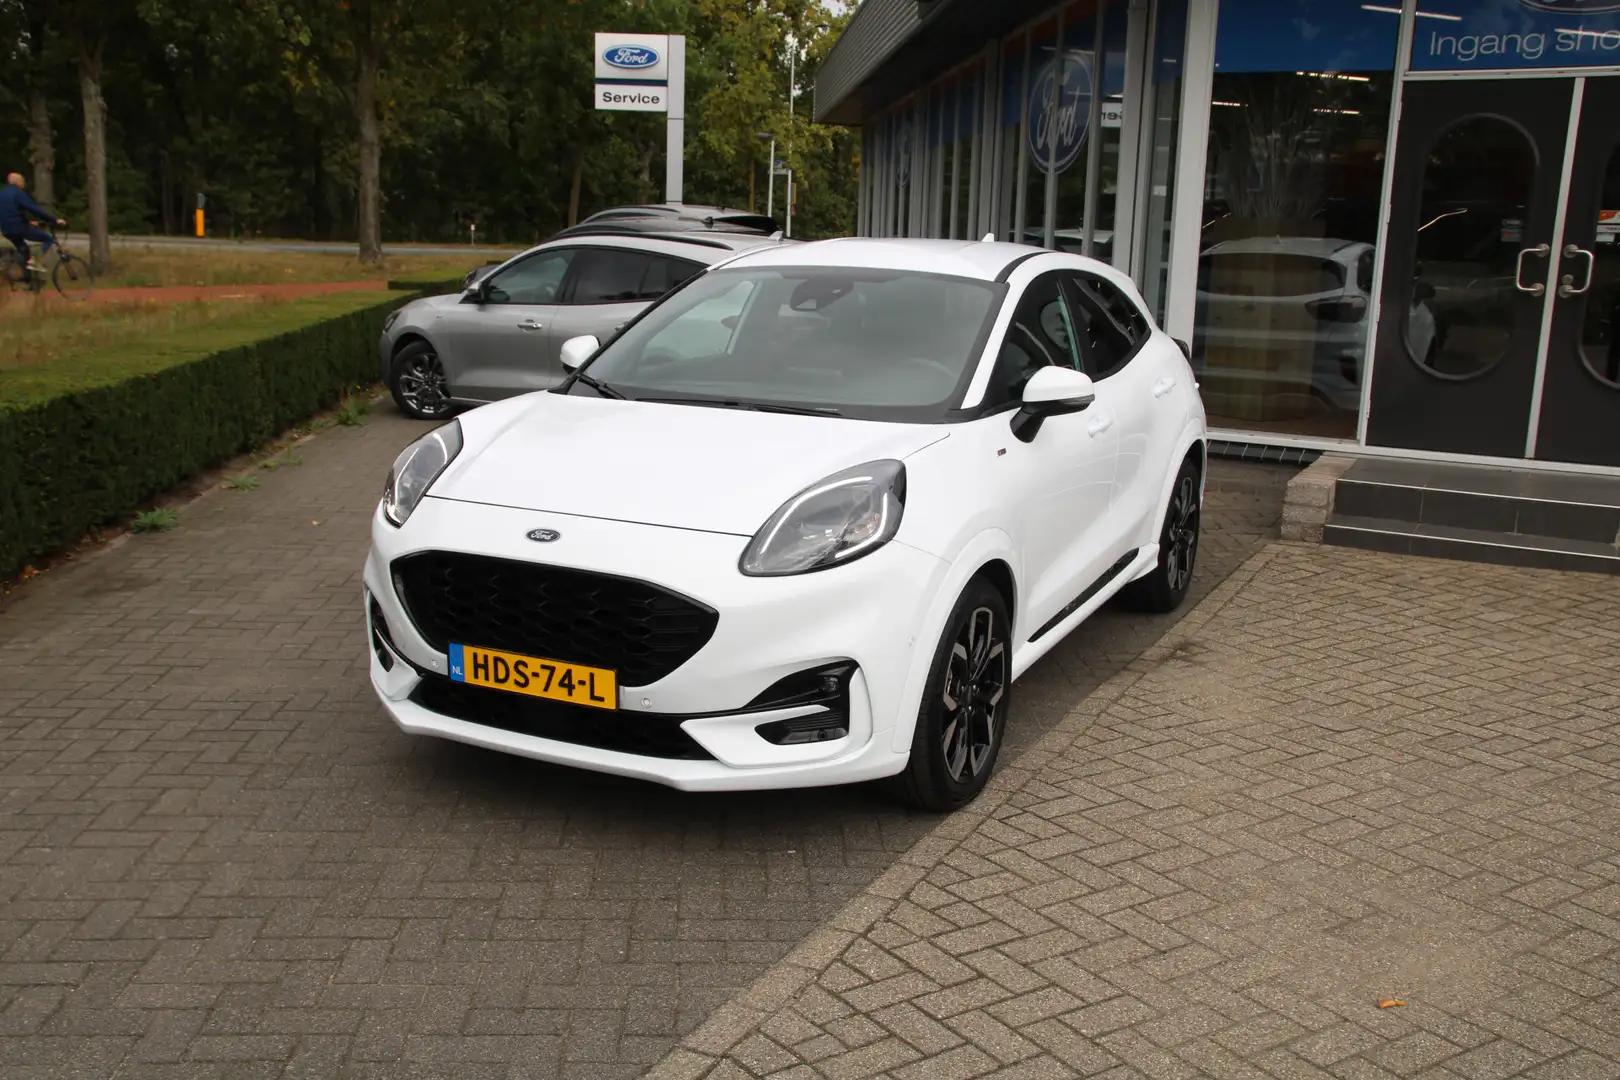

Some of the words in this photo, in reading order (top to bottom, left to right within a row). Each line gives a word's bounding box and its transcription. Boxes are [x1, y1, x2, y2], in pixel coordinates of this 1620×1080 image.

[614, 47, 649, 64] Ford
[1430, 31, 1546, 61] Ingang
[602, 91, 660, 104] Service
[452, 665, 463, 676] NL
[472, 652, 604, 702] HDS-74-L
